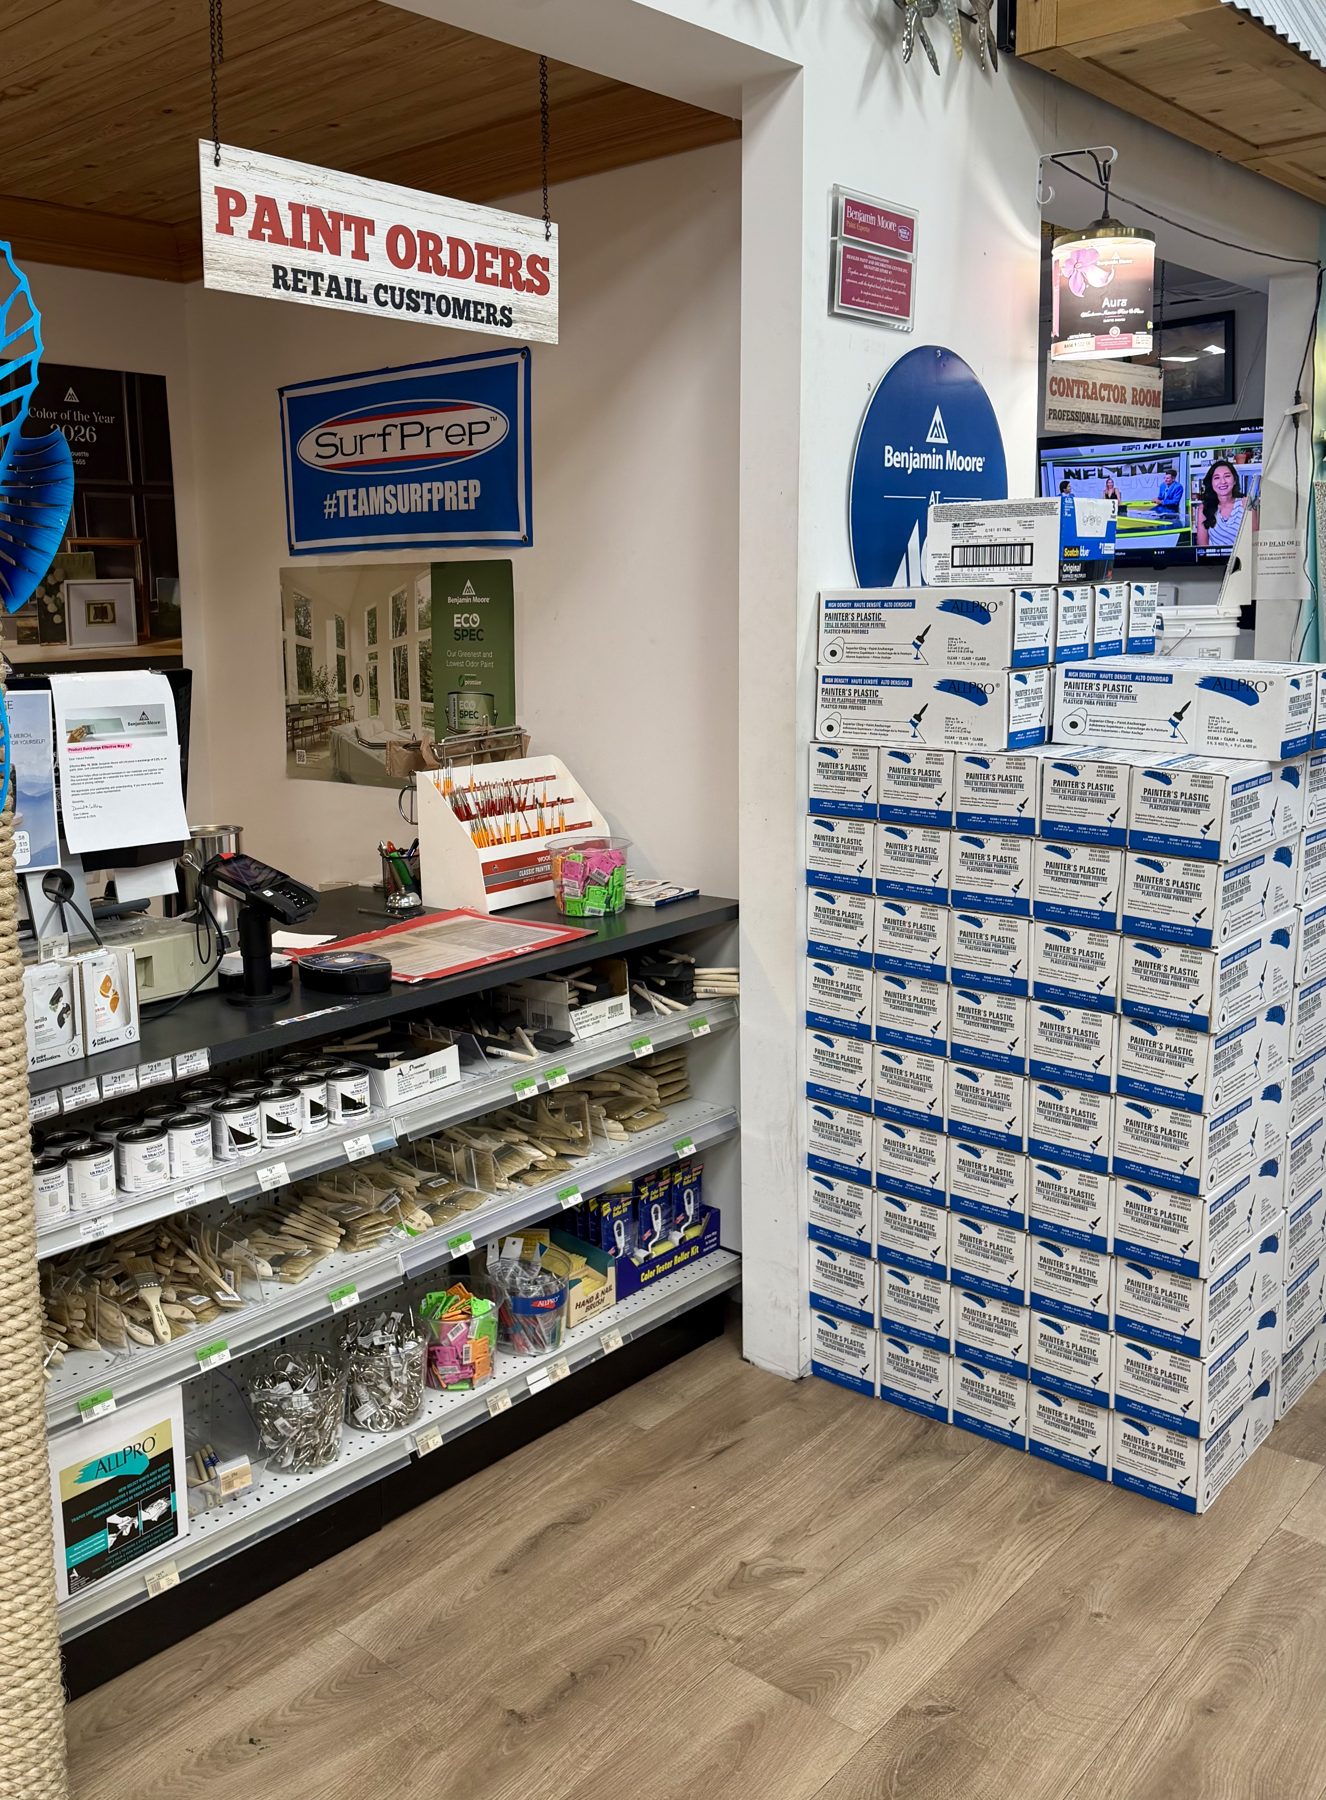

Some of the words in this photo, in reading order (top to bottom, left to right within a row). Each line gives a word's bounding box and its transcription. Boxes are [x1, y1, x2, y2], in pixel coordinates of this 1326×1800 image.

[846, 206, 876, 226] Benjamin
[877, 214, 897, 232] Moore
[213, 186, 375, 262] PAINT
[385, 223, 551, 296] ORDERS
[271, 264, 367, 304] RETAIL
[373, 283, 513, 328] CUSTOMERS
[1102, 297, 1128, 308] Aura
[1049, 376, 1127, 404] CONTRACTOR
[1131, 387, 1161, 408] ROOM
[28, 407, 57, 419] Color
[60, 409, 72, 420] of
[73, 410, 90, 422] the
[92, 411, 116, 424] Year
[1048, 408, 1099, 424] PROFESSIONAL
[1101, 413, 1121, 426] TRADE
[1123, 416, 1138, 428] ONLY
[1139, 417, 1160, 430] PLEASE
[1143, 442, 1164, 450] NFL
[1167, 440, 1191, 448] LIVE
[884, 445, 943, 475] Benjamin
[945, 450, 983, 472] Moore
[1193, 451, 1207, 459] no
[1063, 467, 1111, 480] NFL
[1114, 459, 1173, 477] LIVE
[323, 479, 481, 519] #TEAMSURFPREP
[929, 490, 941, 505] AT
[1111, 501, 1116, 514] 3
[1063, 546, 1079, 558] Scotch
[1062, 563, 1082, 573] Original
[447, 597, 472, 605] Benjamin
[453, 613, 480, 628] ECO
[824, 612, 854, 621] PAINTER'S
[856, 612, 882, 621] PLASTIC
[453, 629, 484, 641] SPEC
[446, 650, 457, 658] Our
[458, 650, 482, 658] Greenest
[482, 650, 493, 658] and
[821, 688, 852, 696] PAINTER'S
[853, 689, 879, 698] PLASTIC
[1063, 681, 1100, 692] PAINTER'S
[1102, 684, 1133, 693] PLASTIC
[1212, 678, 1268, 693] ALLPRO
[459, 701, 476, 710] ECO
[459, 710, 479, 719] SPEC
[818, 761, 843, 769] PAINTER'S
[844, 763, 866, 771] PLASTIC
[889, 766, 916, 774] PAINTER'S
[917, 768, 941, 776] PLASTIC
[966, 771, 995, 780] PAINTER'S
[997, 773, 1023, 782] PLASTIC
[1053, 778, 1085, 788] PAINTER'S
[1086, 781, 1114, 791] PLASTIC
[1143, 786, 1178, 798] PAINTER'S
[1179, 791, 1209, 802] PLASTIC
[518, 868, 535, 877] CLASSIC
[1136, 873, 1170, 886] PAINTER'S
[1171, 878, 1200, 890] PLASTIC
[959, 929, 988, 940] PAINTER'S
[989, 933, 1015, 943] PLASTIC
[1130, 1034, 1163, 1049] PAINTER'S
[1164, 1042, 1193, 1056] PLASTIC
[1038, 1099, 1069, 1113] PAINTER'S
[1070, 1106, 1096, 1119] PLASTIC
[884, 1137, 910, 1150] PAINTER'S
[911, 1144, 934, 1156] PLASTIC
[814, 1189, 838, 1202] PAINTER'S
[839, 1197, 861, 1209] PLASTIC
[1125, 1199, 1158, 1215] PAINTER'S
[1159, 1208, 1187, 1223] PLASTIC
[960, 1232, 987, 1247] PAINTER'S
[988, 1241, 1013, 1254] PLASTIC
[640, 1269, 655, 1282] Color
[655, 1260, 672, 1276] Tester
[673, 1251, 689, 1266] Roller
[690, 1245, 700, 1257] Kit
[574, 1296, 593, 1310] HAND
[593, 1293, 600, 1301] &
[601, 1284, 613, 1297] NAIL
[584, 1297, 606, 1313] BRUSH
[1040, 1332, 1069, 1348] PAINTER'S
[1071, 1342, 1096, 1356] PLASTIC
[888, 1351, 913, 1366] PAINTER'S
[915, 1360, 937, 1374] PLASTIC
[1123, 1431, 1155, 1449] PAINTER'S
[1156, 1443, 1184, 1459] PLASTIC
[95, 1436, 156, 1479] ALLPRO
